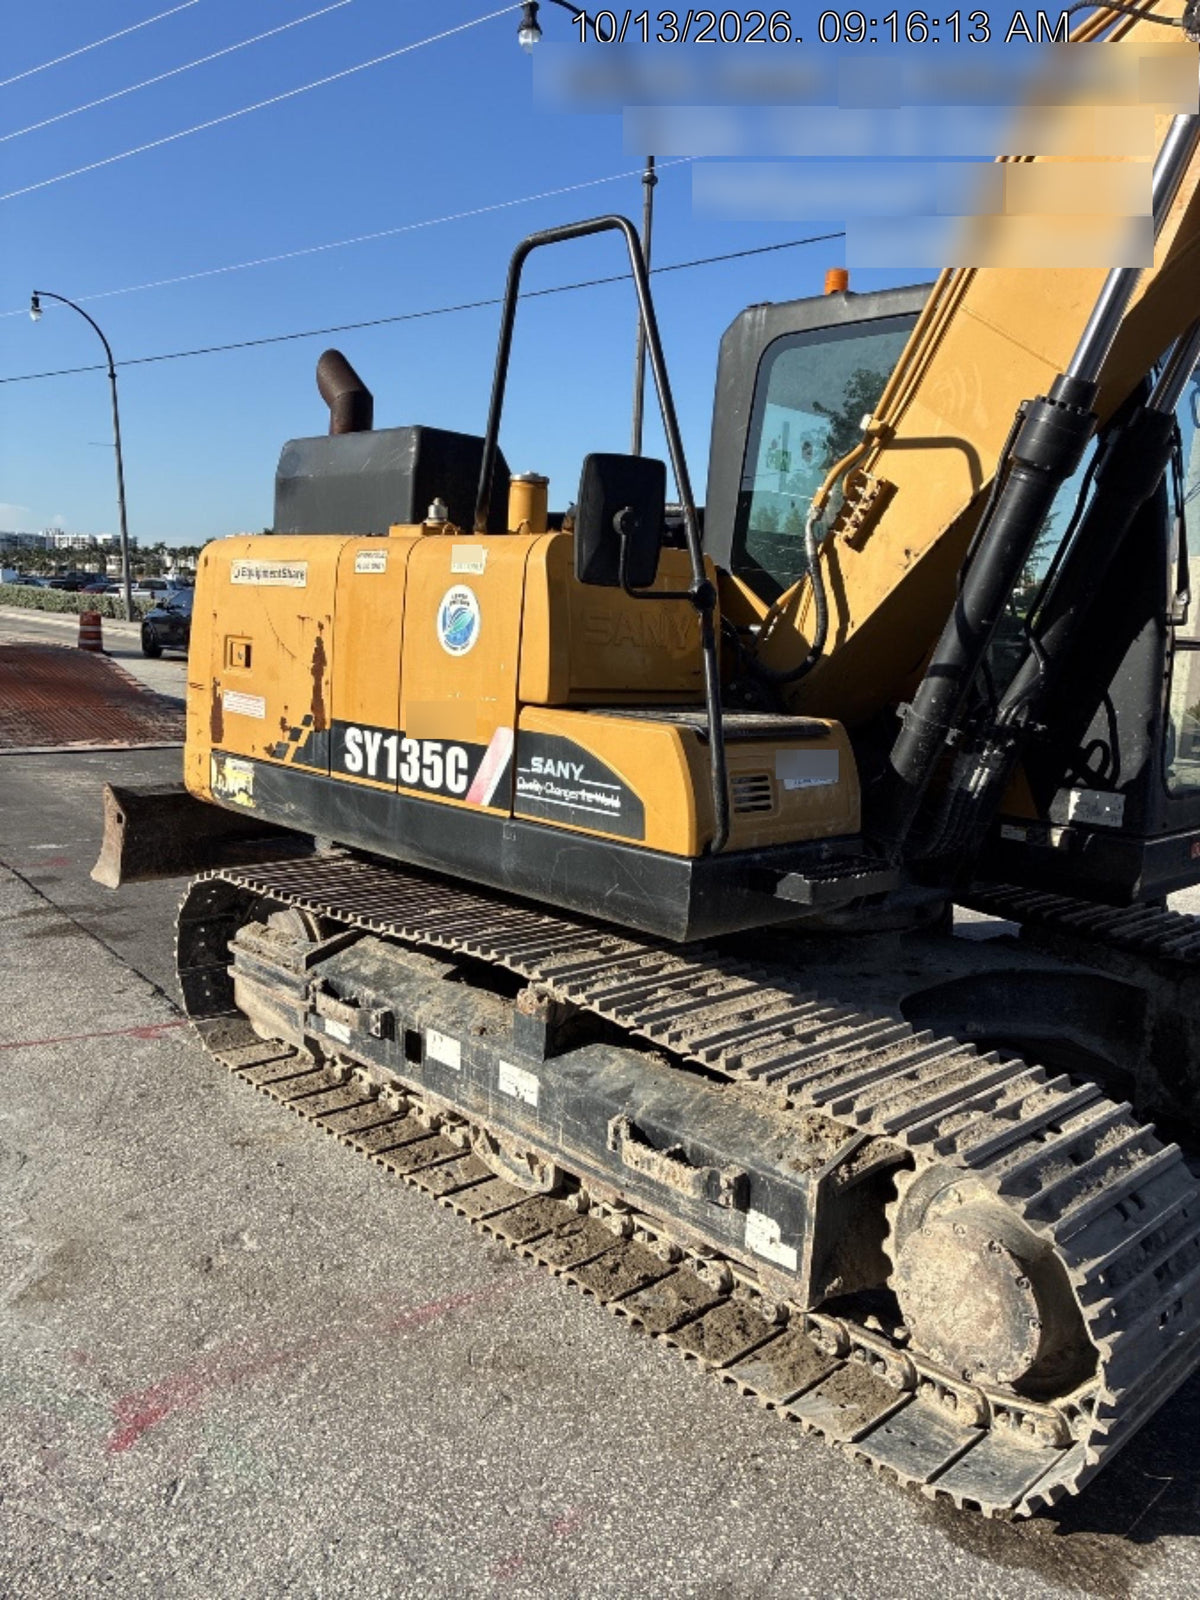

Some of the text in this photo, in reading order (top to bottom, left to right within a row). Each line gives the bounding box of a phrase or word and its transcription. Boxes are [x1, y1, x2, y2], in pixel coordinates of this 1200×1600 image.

[582, 608, 694, 651] SANY
[344, 726, 468, 793] SY135C
[531, 756, 584, 781] SANY
[517, 777, 542, 795] Quality
